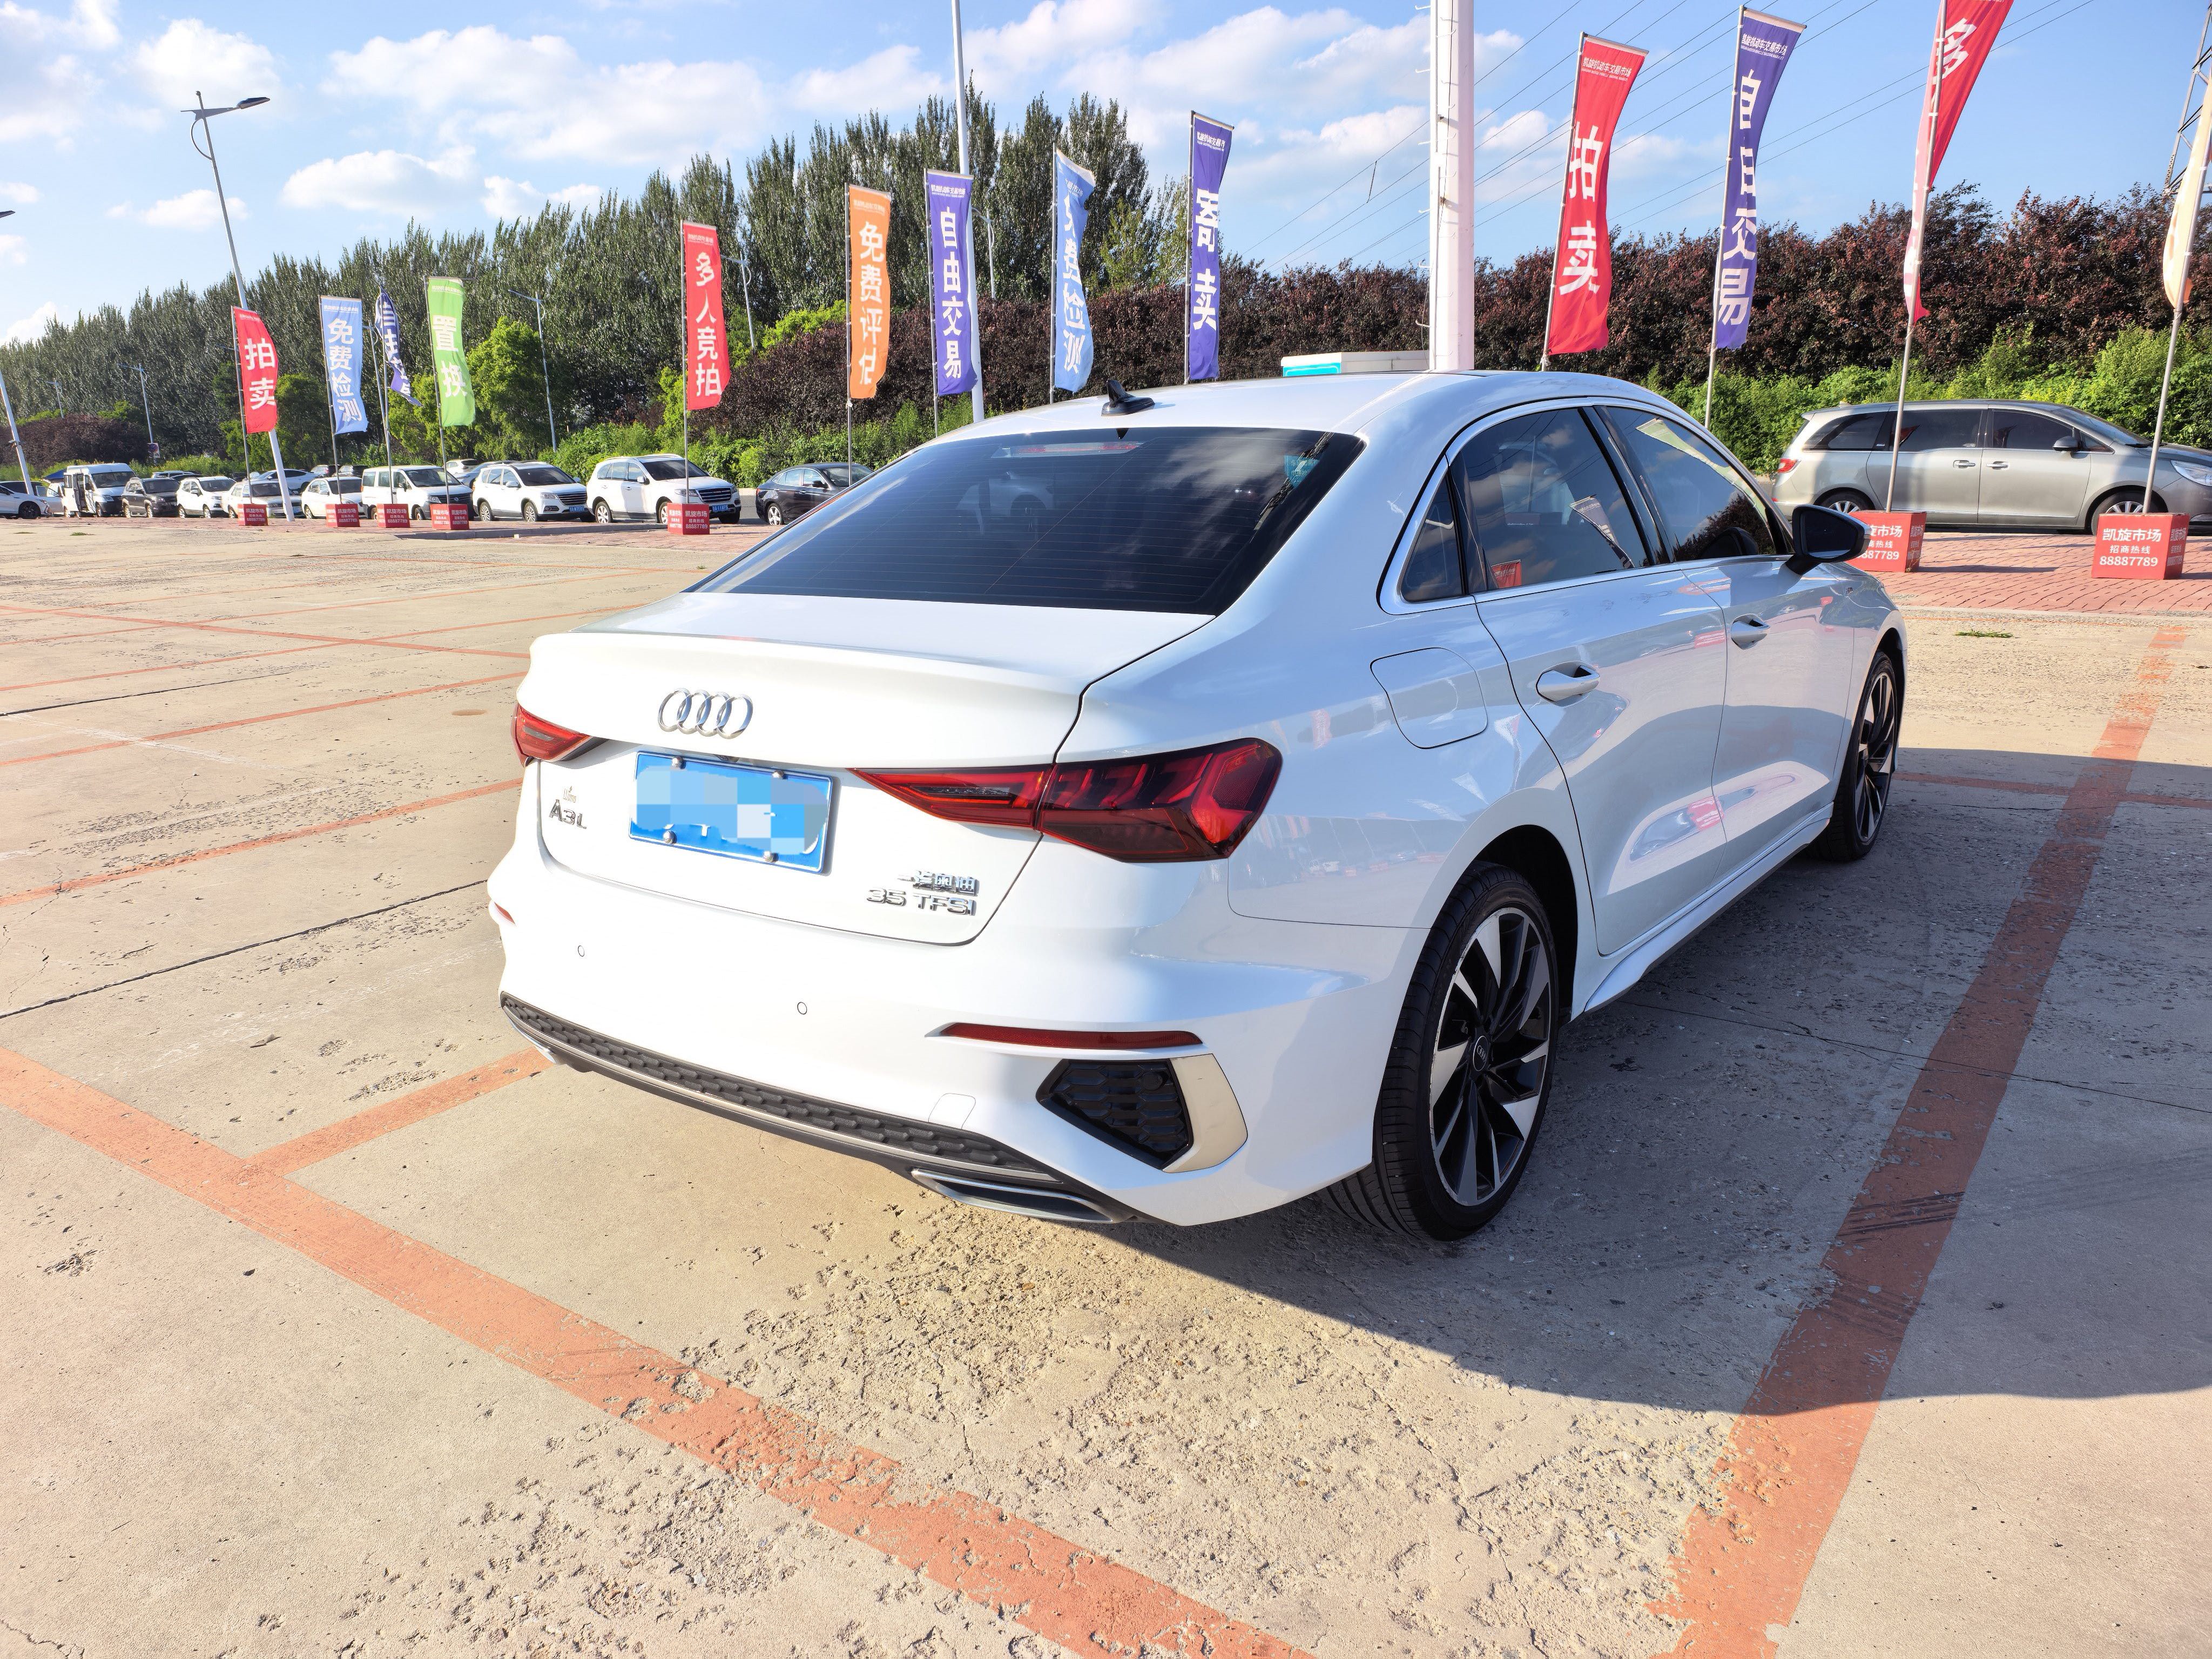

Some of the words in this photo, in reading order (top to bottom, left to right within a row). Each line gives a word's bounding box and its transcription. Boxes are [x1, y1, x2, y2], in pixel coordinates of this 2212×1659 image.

[1741, 33, 1788, 56] 凯旋机动车交易市场
[1582, 57, 1633, 77] 凯旋机动车交易市场
[1559, 121, 1604, 295] 拍卖
[940, 206, 965, 379] 自由交易
[696, 252, 723, 397] 多人竞拍
[433, 315, 468, 398] 置换
[245, 338, 276, 410] 拍卖
[328, 318, 361, 422] 免费检测
[1870, 524, 1903, 537] 市场
[2102, 528, 2162, 542] 凯旋市场
[1857, 550, 1899, 559] 887789
[1868, 540, 1893, 548] 商热线
[2110, 545, 2151, 554] 招商热线
[2099, 556, 2159, 567] 88887789
[549, 799, 587, 830] A3L
[866, 887, 907, 906] 35
[913, 892, 976, 916] TFSI
